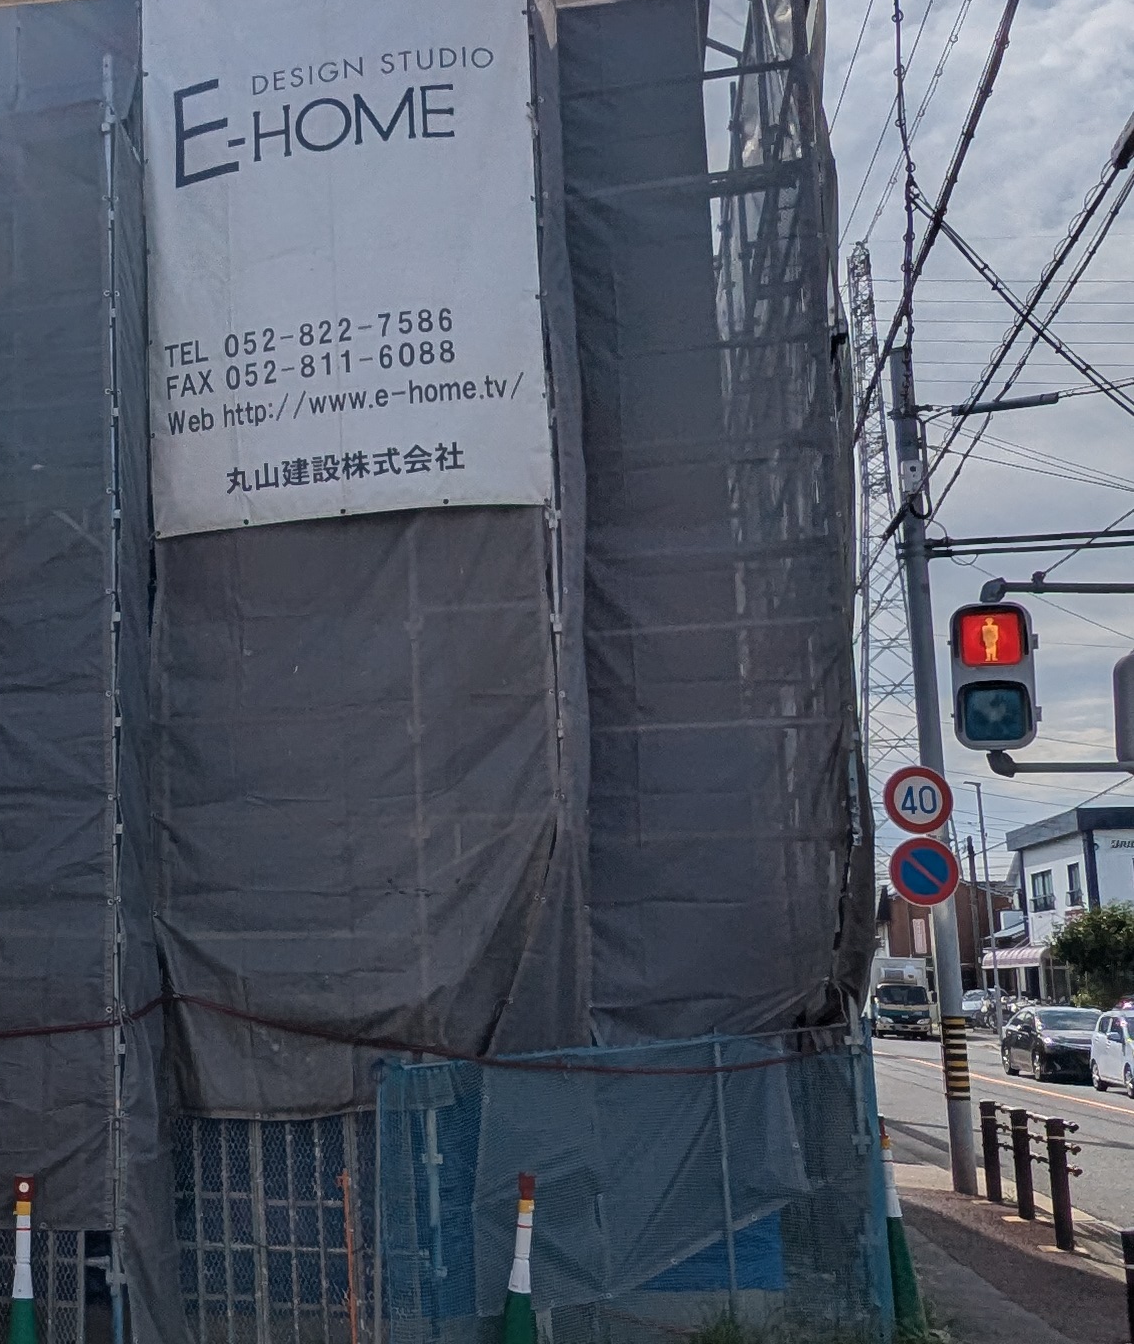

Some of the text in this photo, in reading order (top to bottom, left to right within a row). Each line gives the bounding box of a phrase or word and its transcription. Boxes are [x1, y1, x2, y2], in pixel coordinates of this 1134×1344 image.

[251, 46, 495, 96] DESIGN STUDIO
[174, 78, 456, 189] E-HOME
[165, 307, 454, 368] TEL 052-822-7586
[166, 339, 456, 401] FAX 052-811-6088
[167, 371, 525, 436] Web http://www.e-home.tv/
[226, 441, 466, 495] 丸山建設株式会社
[901, 785, 938, 814] 40
